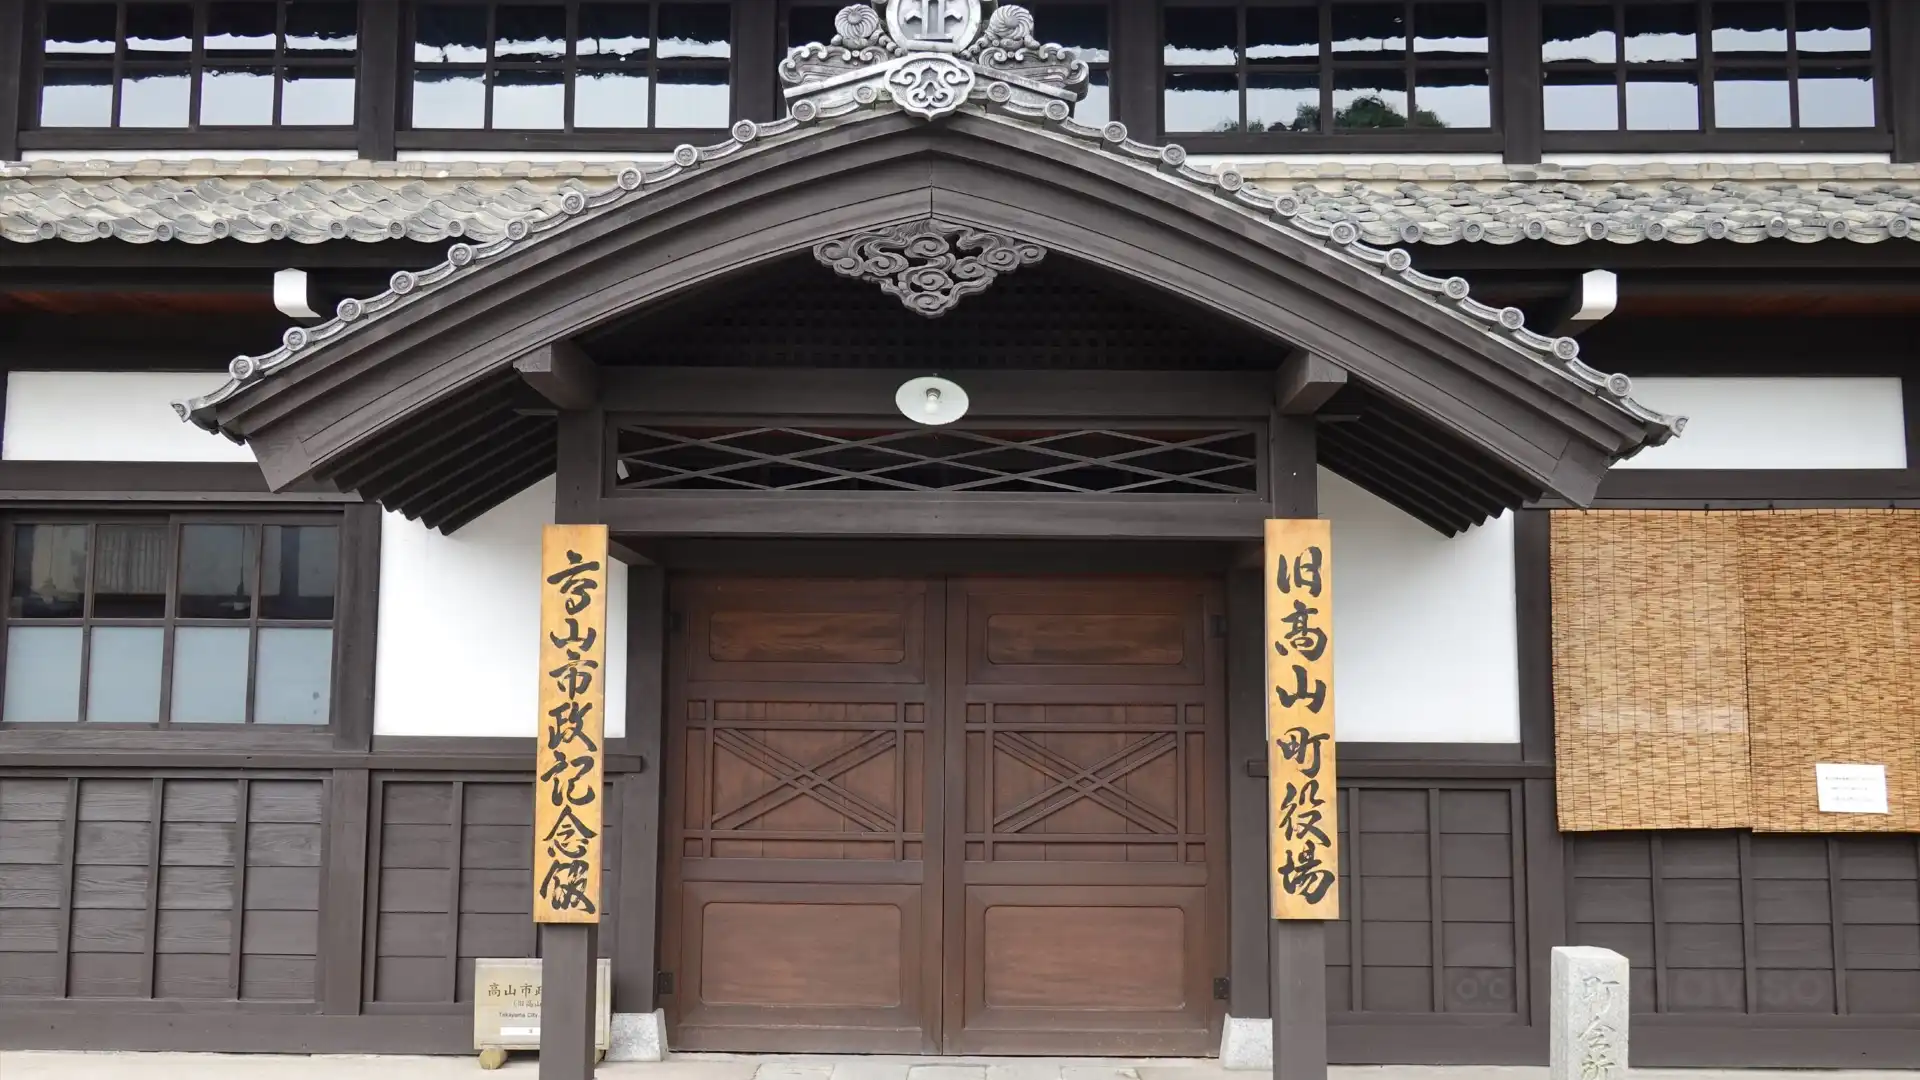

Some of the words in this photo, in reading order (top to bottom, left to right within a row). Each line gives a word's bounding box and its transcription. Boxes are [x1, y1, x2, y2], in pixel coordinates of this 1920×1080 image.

[1275, 544, 1335, 906] 旧高山町役場
